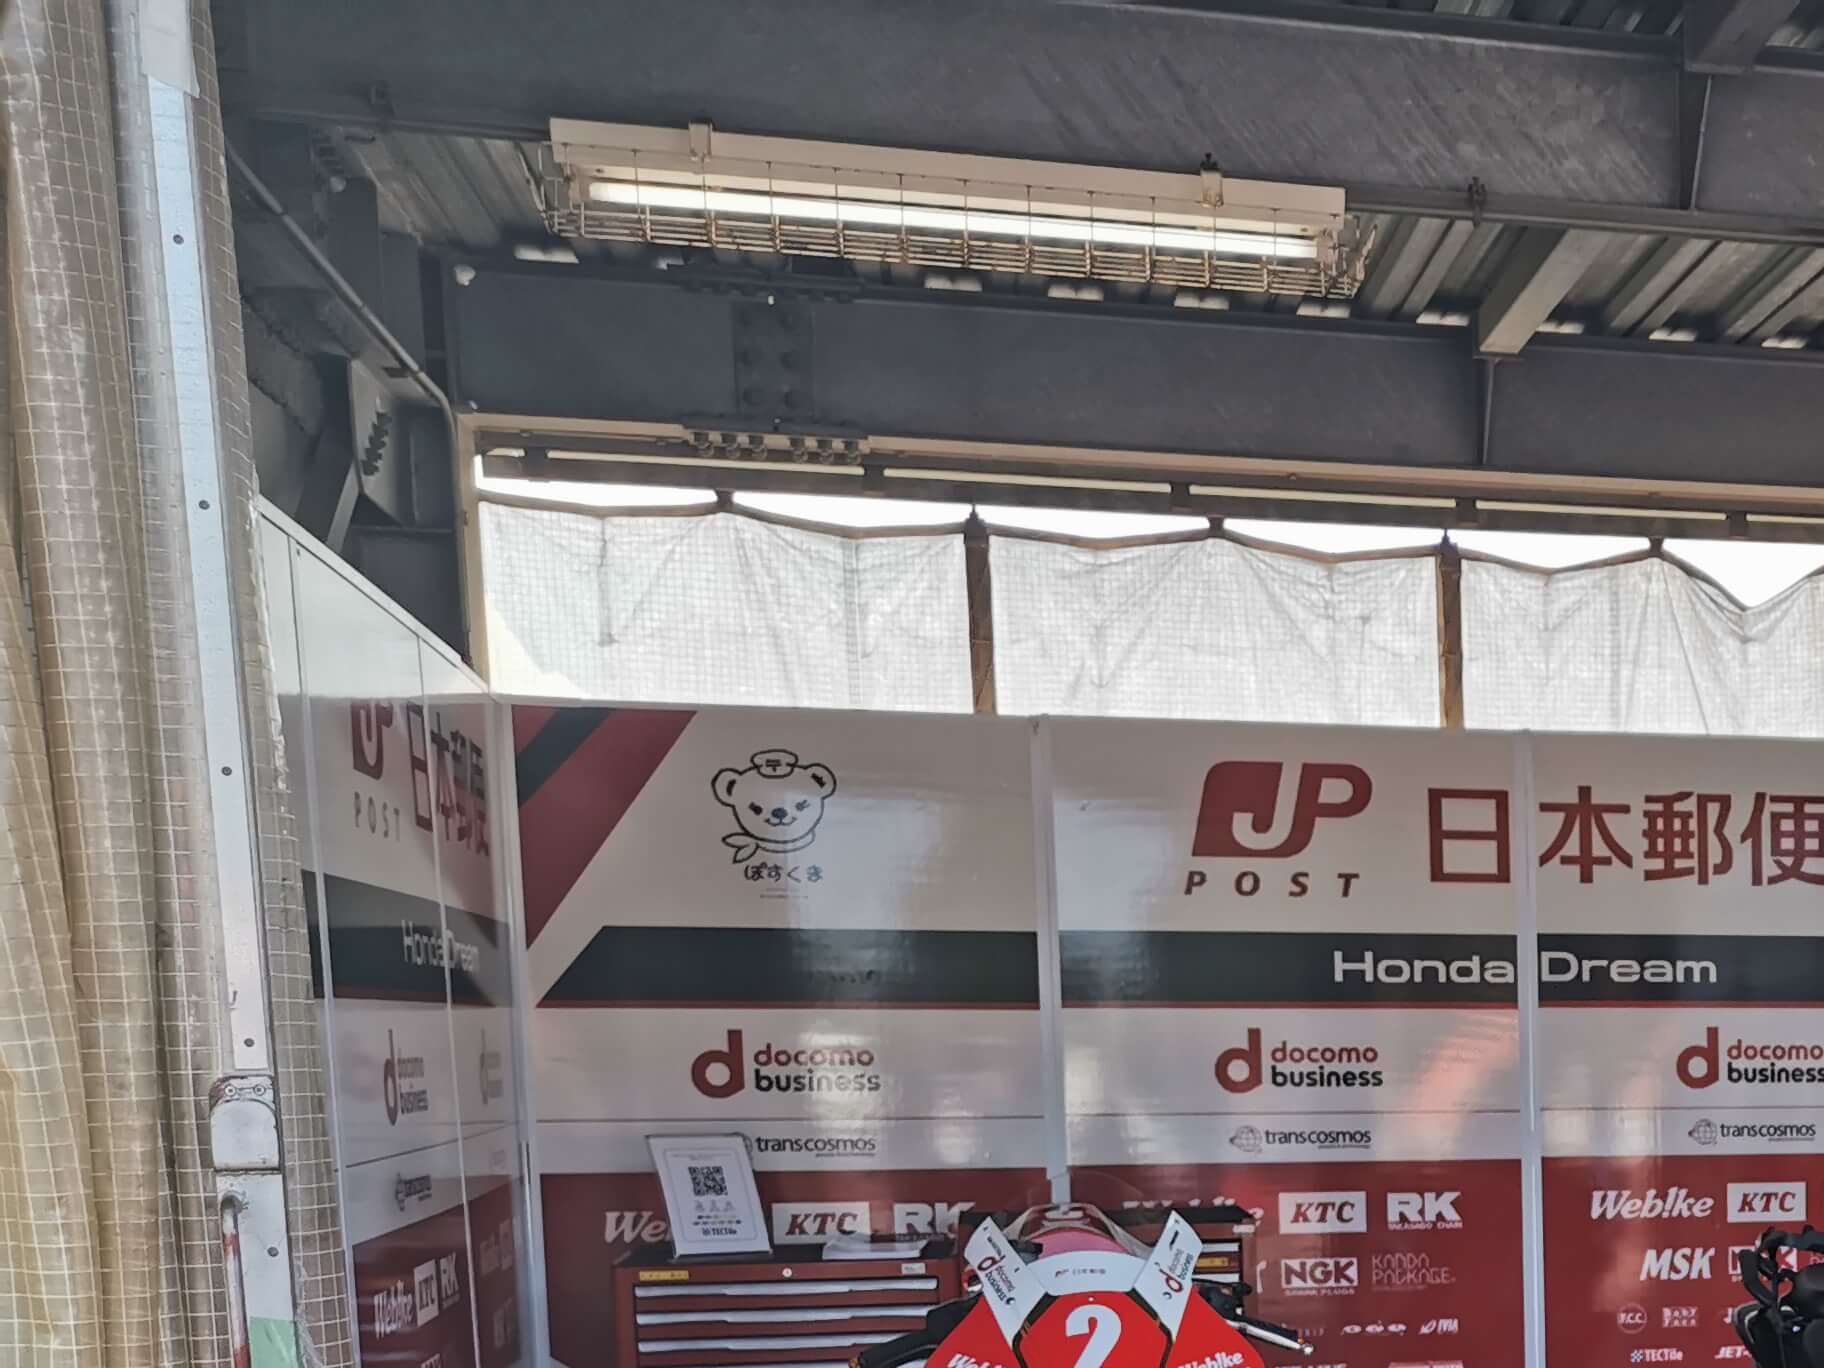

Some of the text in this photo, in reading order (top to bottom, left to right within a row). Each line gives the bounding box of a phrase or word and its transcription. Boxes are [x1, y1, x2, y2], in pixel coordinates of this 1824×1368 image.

[1191, 761, 1373, 858] JP
[744, 862, 823, 882] ぽすくま
[1184, 870, 1360, 897] POST
[1333, 950, 1718, 984] Honda Dream
[753, 1043, 875, 1066] docomo
[1271, 1041, 1378, 1065] docomo
[1726, 1039, 1824, 1061] docomo
[755, 1069, 881, 1092] business
[1271, 1064, 1383, 1088] business
[1290, 1202, 1355, 1223] KTC
[1387, 1192, 1461, 1222] RK
[1737, 1192, 1796, 1212] KTC
[786, 1212, 858, 1236] KTC
[1284, 1260, 1355, 1287] NGK
[1640, 1248, 1715, 1280] MSK
